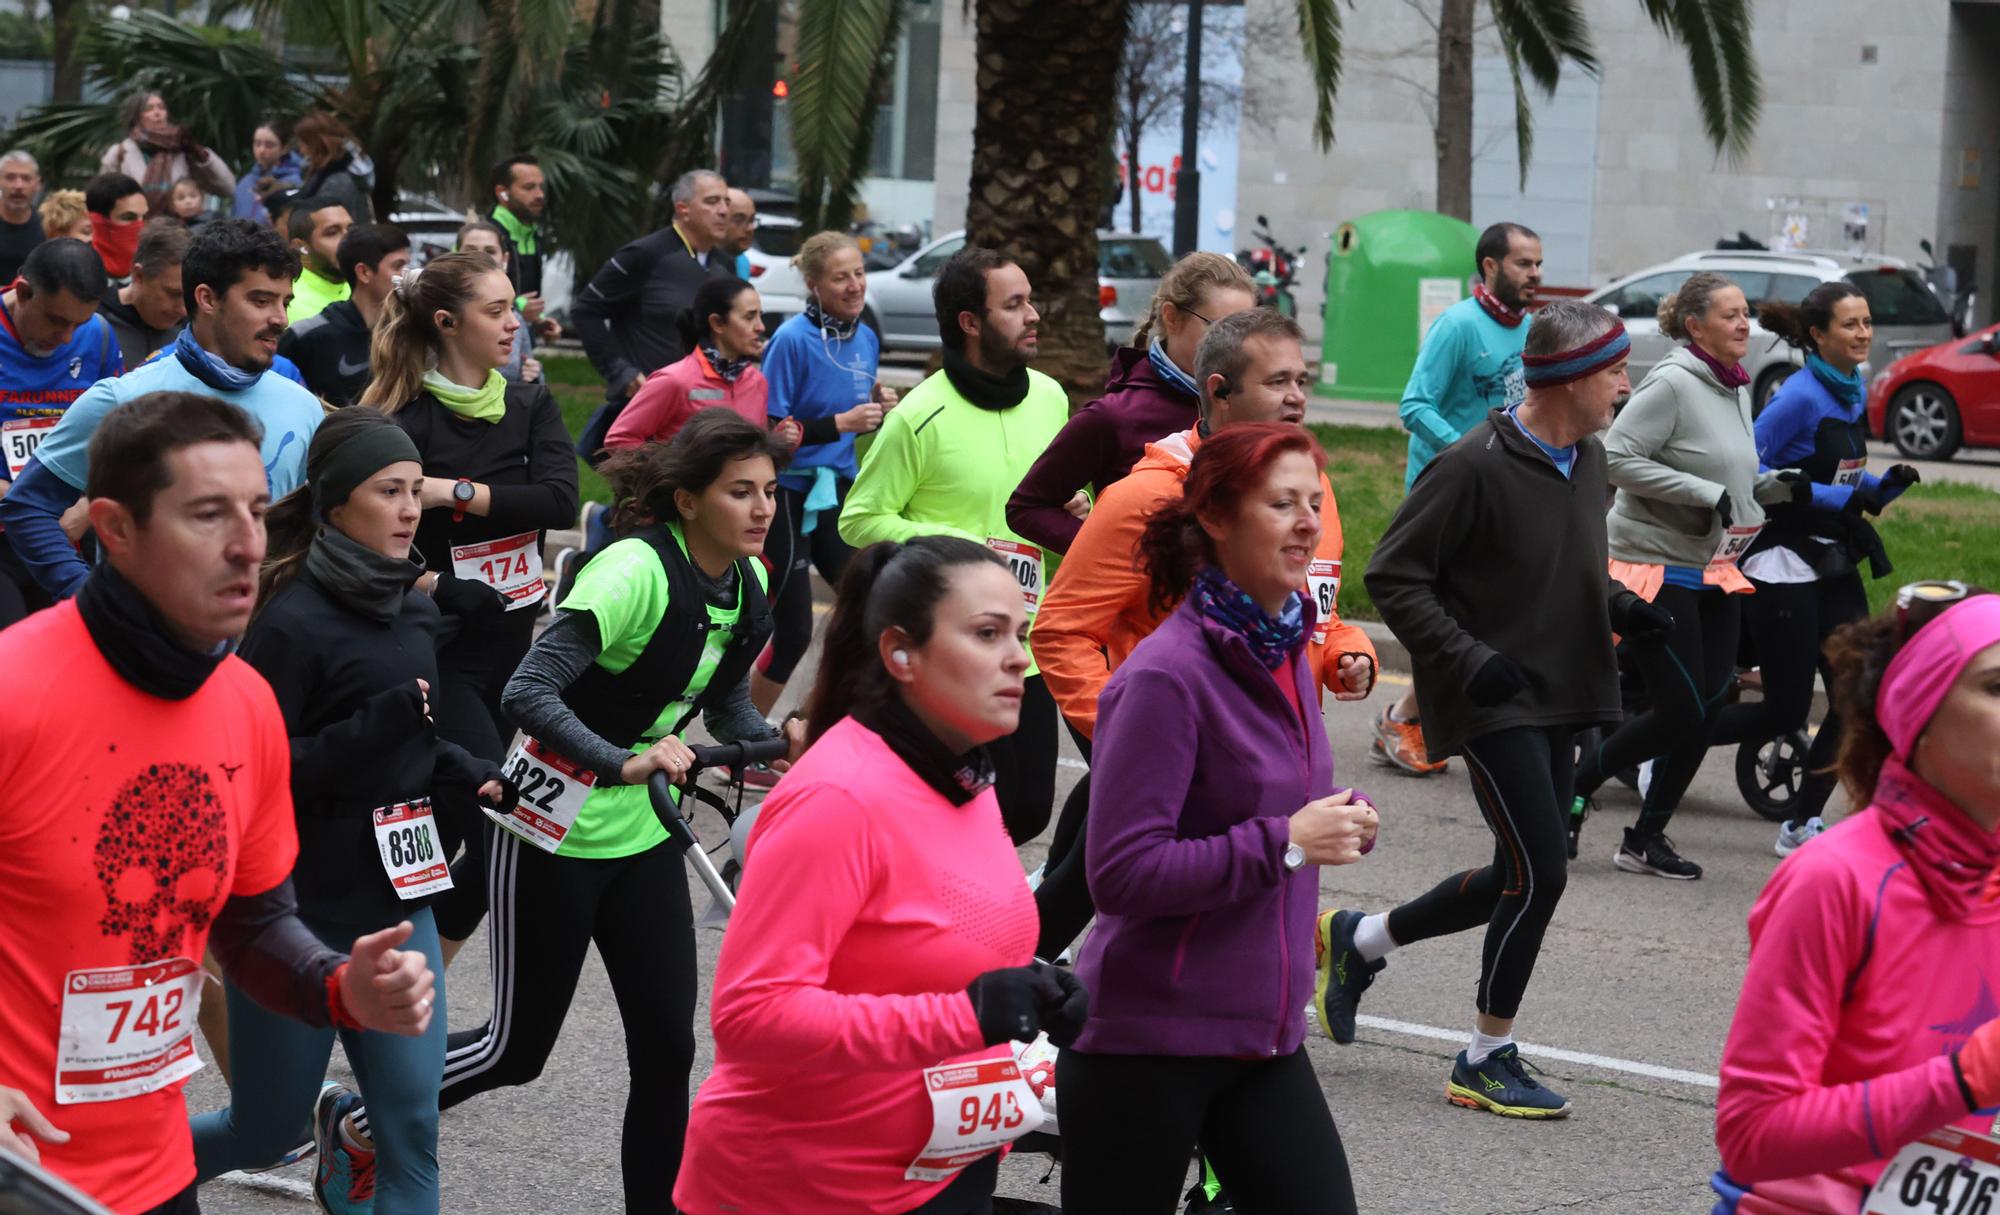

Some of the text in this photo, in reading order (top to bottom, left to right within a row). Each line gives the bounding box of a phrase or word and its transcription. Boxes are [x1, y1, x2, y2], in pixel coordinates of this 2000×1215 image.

[480, 552, 529, 584] 174
[388, 823, 434, 867] 8388
[105, 987, 184, 1044] 742
[957, 1090, 1025, 1137] 943
[1899, 1155, 2000, 1215] 6476
